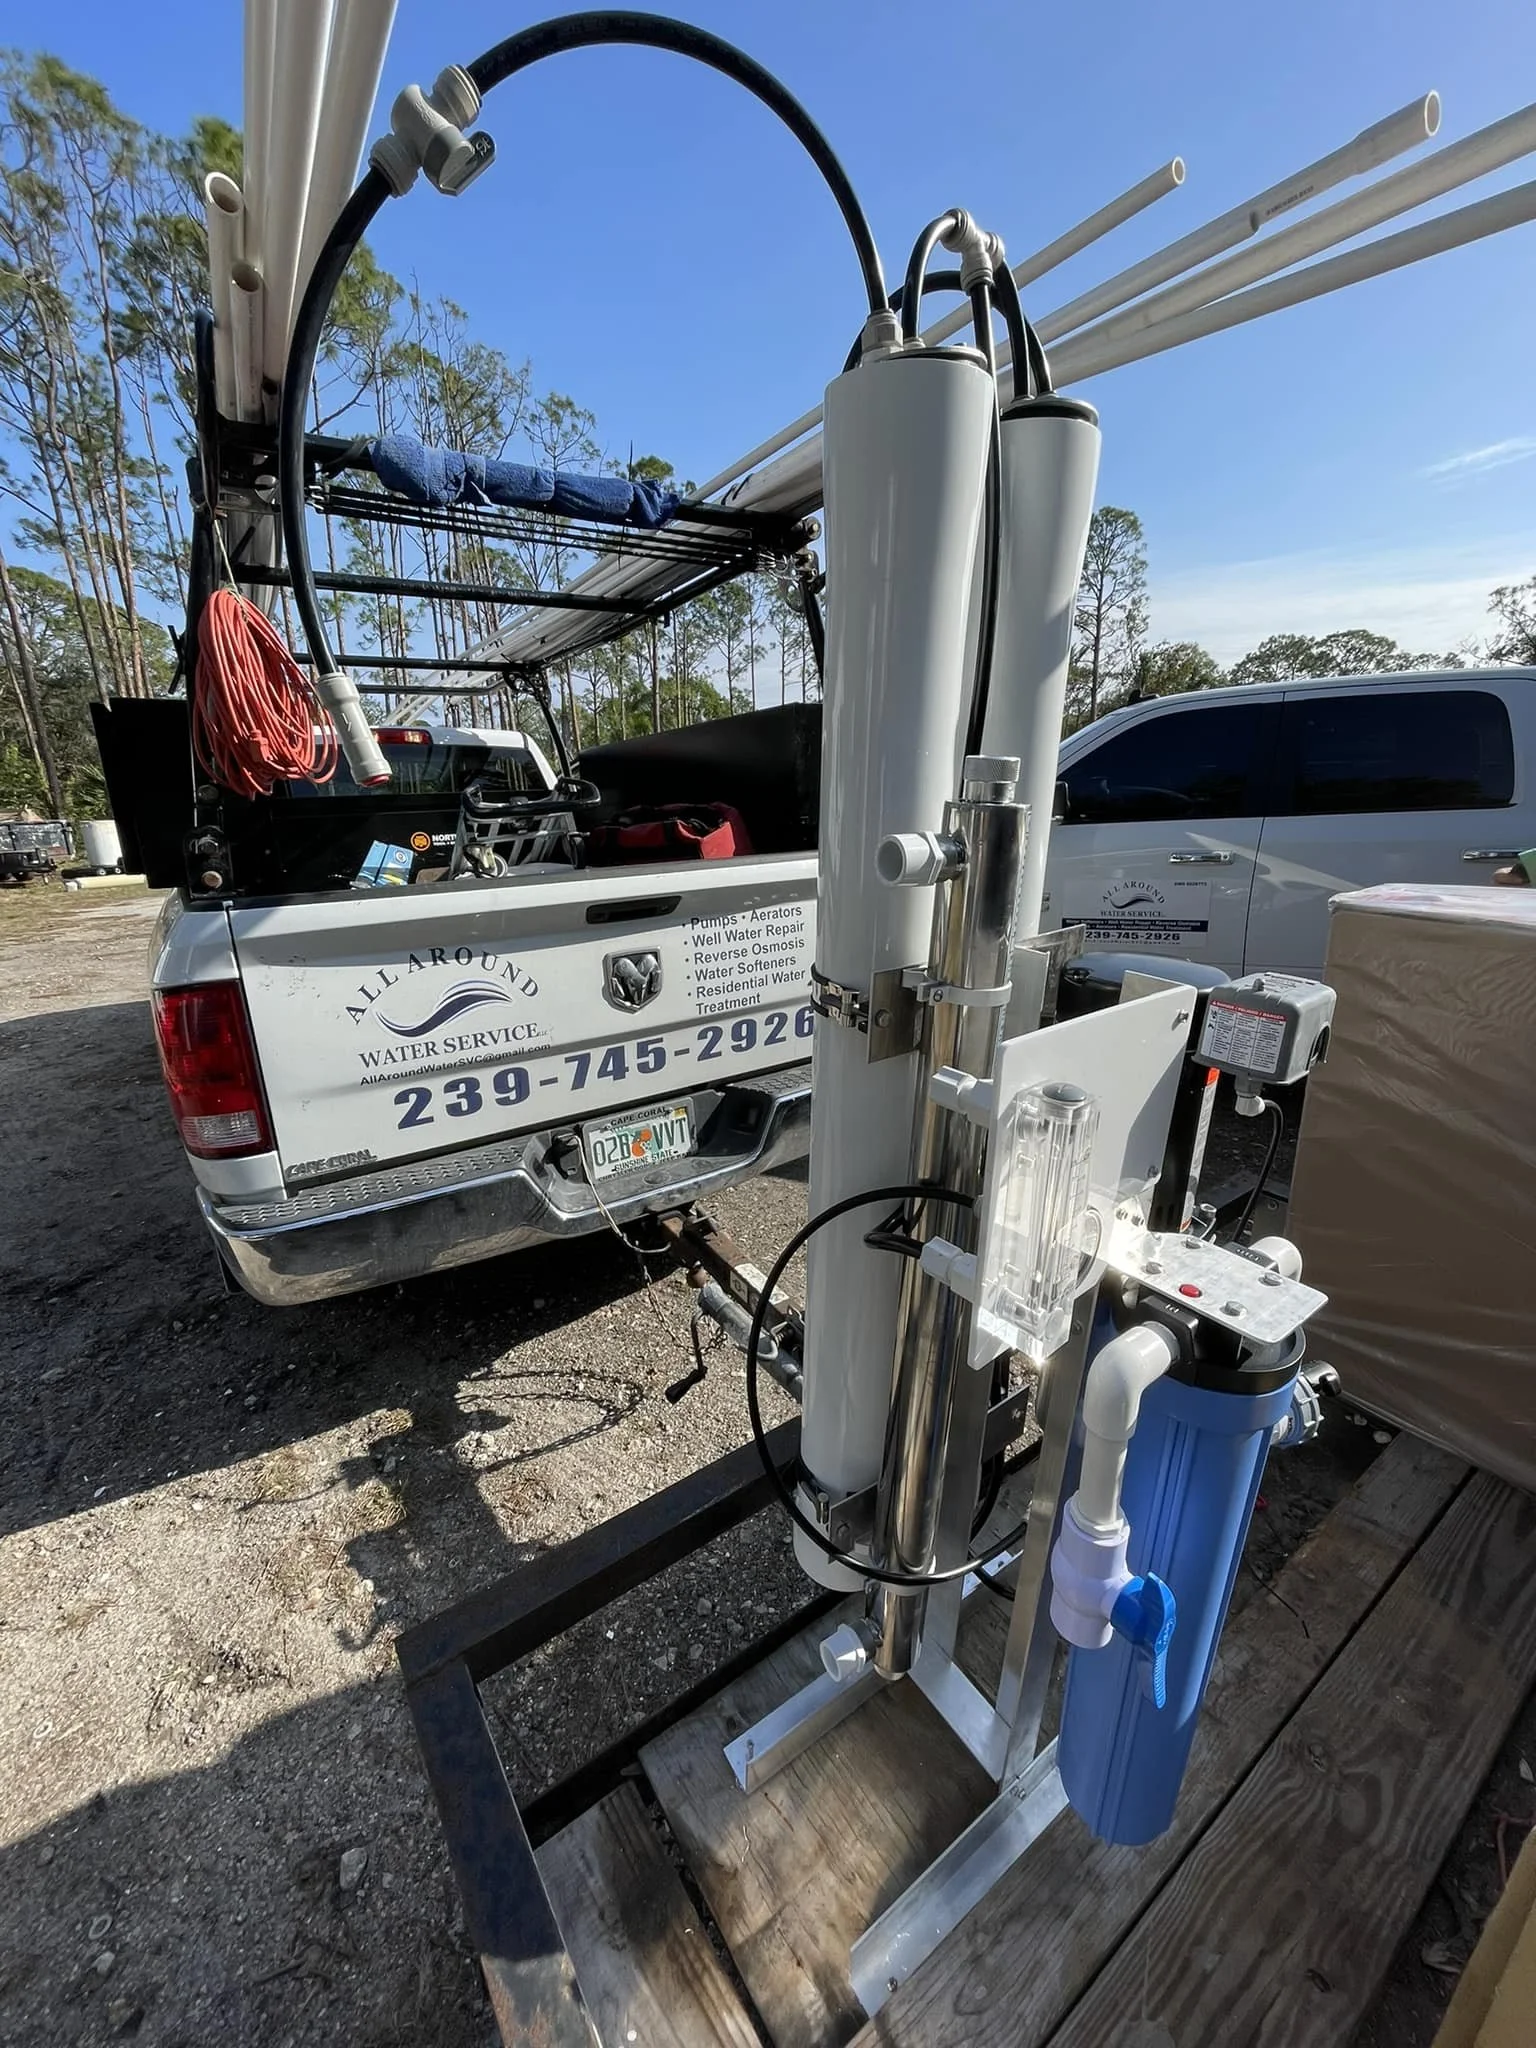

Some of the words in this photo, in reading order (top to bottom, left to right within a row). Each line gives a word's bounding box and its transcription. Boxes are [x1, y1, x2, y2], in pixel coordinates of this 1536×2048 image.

[1102, 886, 1120, 902] ALL
[1123, 881, 1165, 904] AROUND
[690, 914, 738, 931] Pumps
[750, 905, 802, 922] Aerators
[692, 932, 722, 948] Well
[724, 928, 761, 944] Water
[766, 921, 805, 938] Repair
[1085, 931, 1180, 941] 239-745-2926
[694, 948, 748, 965] Reverse
[752, 938, 805, 956] Osmosis
[695, 966, 733, 982] Water
[737, 956, 796, 974] Softeners
[345, 968, 398, 1024] ALL
[407, 946, 539, 998] AROUND
[696, 976, 768, 998] Residential
[772, 969, 806, 985] Water
[696, 993, 761, 1015] Treatment
[358, 1041, 440, 1069] WATER
[443, 1022, 540, 1054] SERVICE
[360, 1044, 551, 1086] AllAroundWaterSVC@gmail.com
[394, 1006, 816, 1130] 239-745-2926
[610, 1113, 635, 1126] CAPE
[638, 1106, 667, 1120] CORAL
[652, 1148, 672, 1160] STATE
